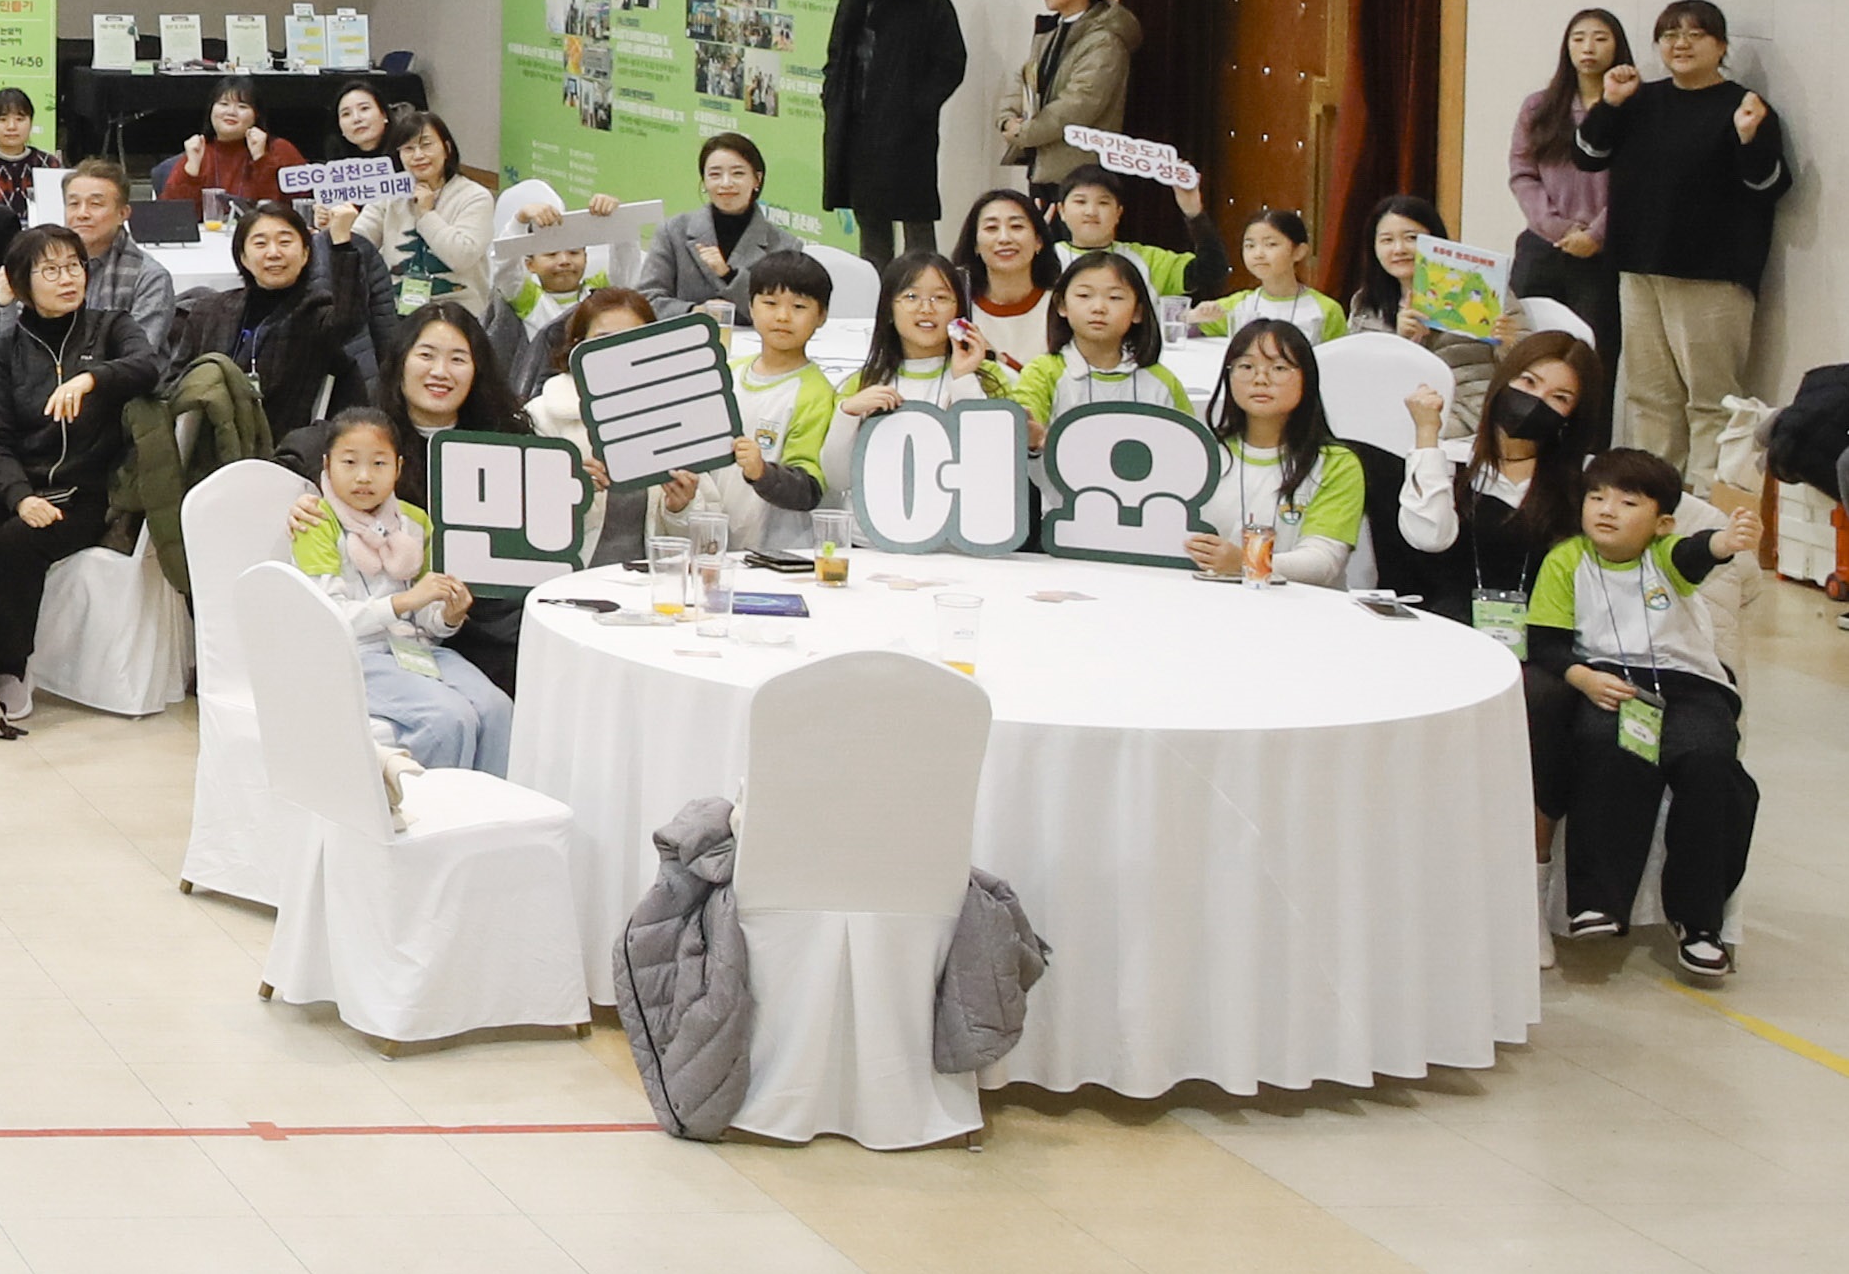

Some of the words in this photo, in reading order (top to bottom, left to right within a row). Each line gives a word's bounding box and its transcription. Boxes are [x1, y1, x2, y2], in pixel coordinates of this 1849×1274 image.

[1071, 129, 1173, 163] 지속가능도시
[285, 170, 325, 188] ESG
[329, 161, 390, 185] 실천으로
[1106, 151, 1152, 173] ESG
[1156, 162, 1193, 184] 성동
[319, 182, 377, 205] 함께하는
[379, 177, 412, 196] 미래
